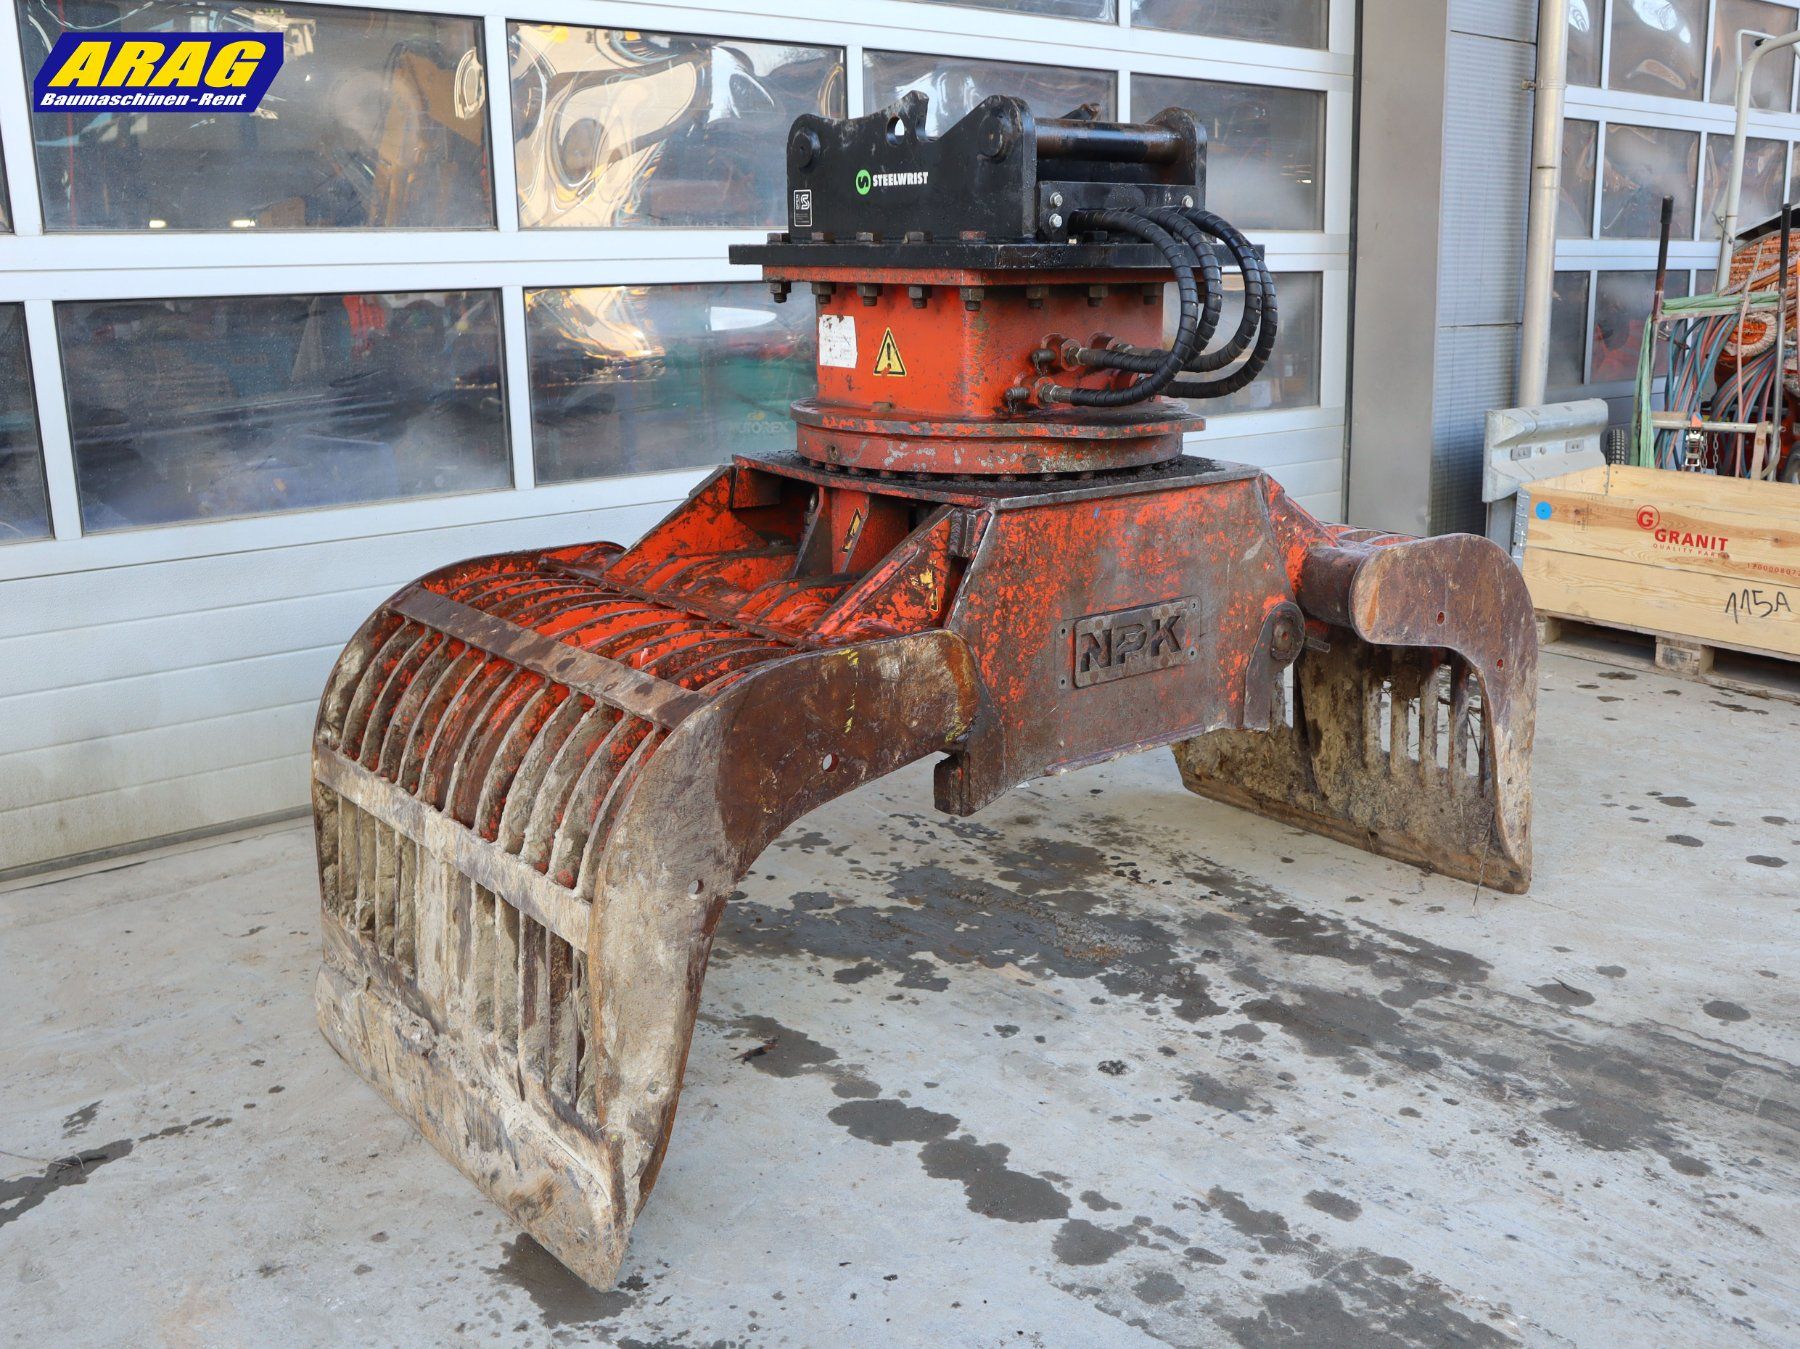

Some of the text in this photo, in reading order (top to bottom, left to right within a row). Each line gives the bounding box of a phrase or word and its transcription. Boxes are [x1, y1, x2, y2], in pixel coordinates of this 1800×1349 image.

[872, 171, 929, 187] STEELWRIST
[1652, 543, 1693, 554] QUALITY
[1654, 528, 1729, 551] GRANIT
[1725, 588, 1792, 625] 115A
[1080, 615, 1182, 673] NPK
